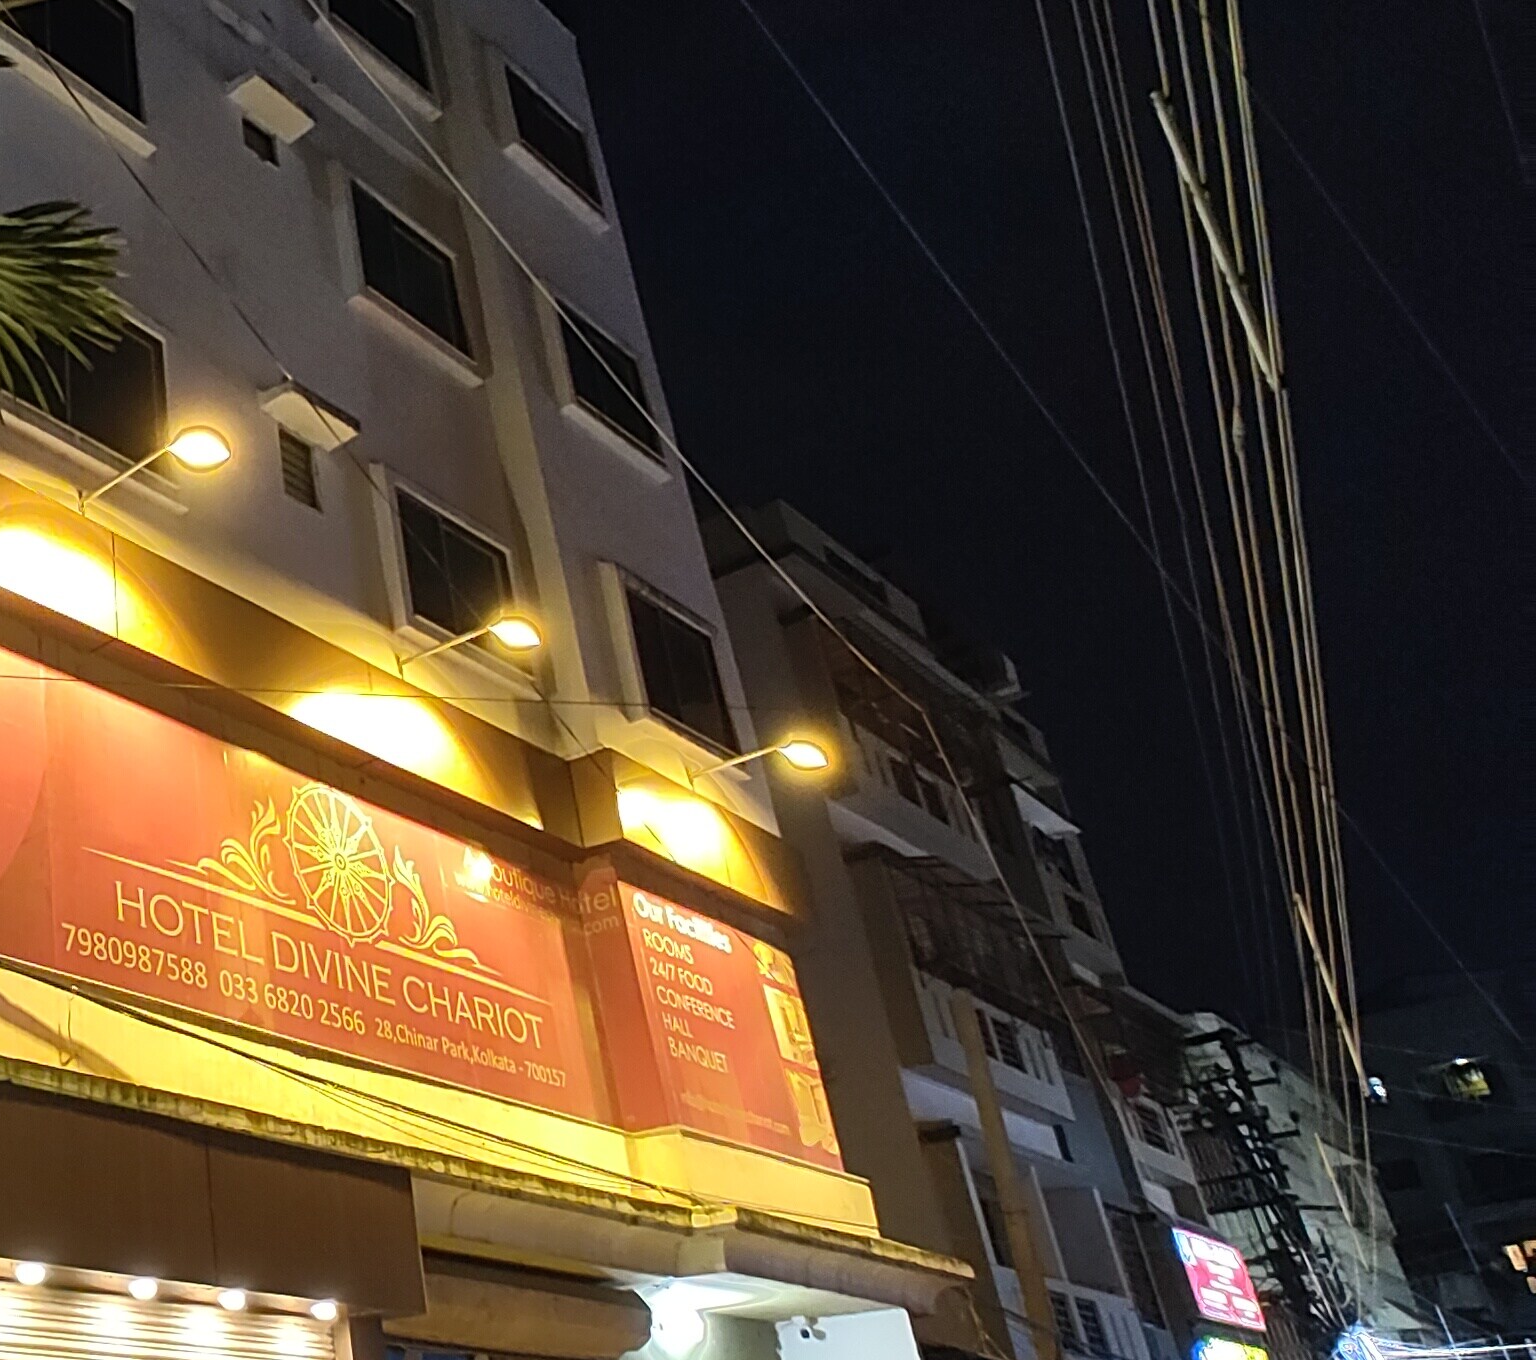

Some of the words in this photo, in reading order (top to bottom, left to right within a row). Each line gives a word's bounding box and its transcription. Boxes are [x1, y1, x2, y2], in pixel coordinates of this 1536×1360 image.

[632, 892, 665, 924] Our
[115, 880, 265, 965] HOTEL
[271, 930, 396, 1006] DIVINE
[402, 976, 543, 1049] CHARIOT
[642, 927, 695, 966] ROOMS
[649, 956, 676, 980] 24/7
[678, 968, 714, 997] FOOD
[61, 922, 208, 990] 7980987588
[218, 969, 259, 1005] 033
[263, 983, 314, 1021] 6820
[317, 998, 366, 1036] 2566
[526, 1060, 566, 1088] 700157
[656, 985, 736, 1030] CONFERENCE
[662, 1012, 694, 1039] HALL
[667, 1036, 729, 1074] BANQUET
